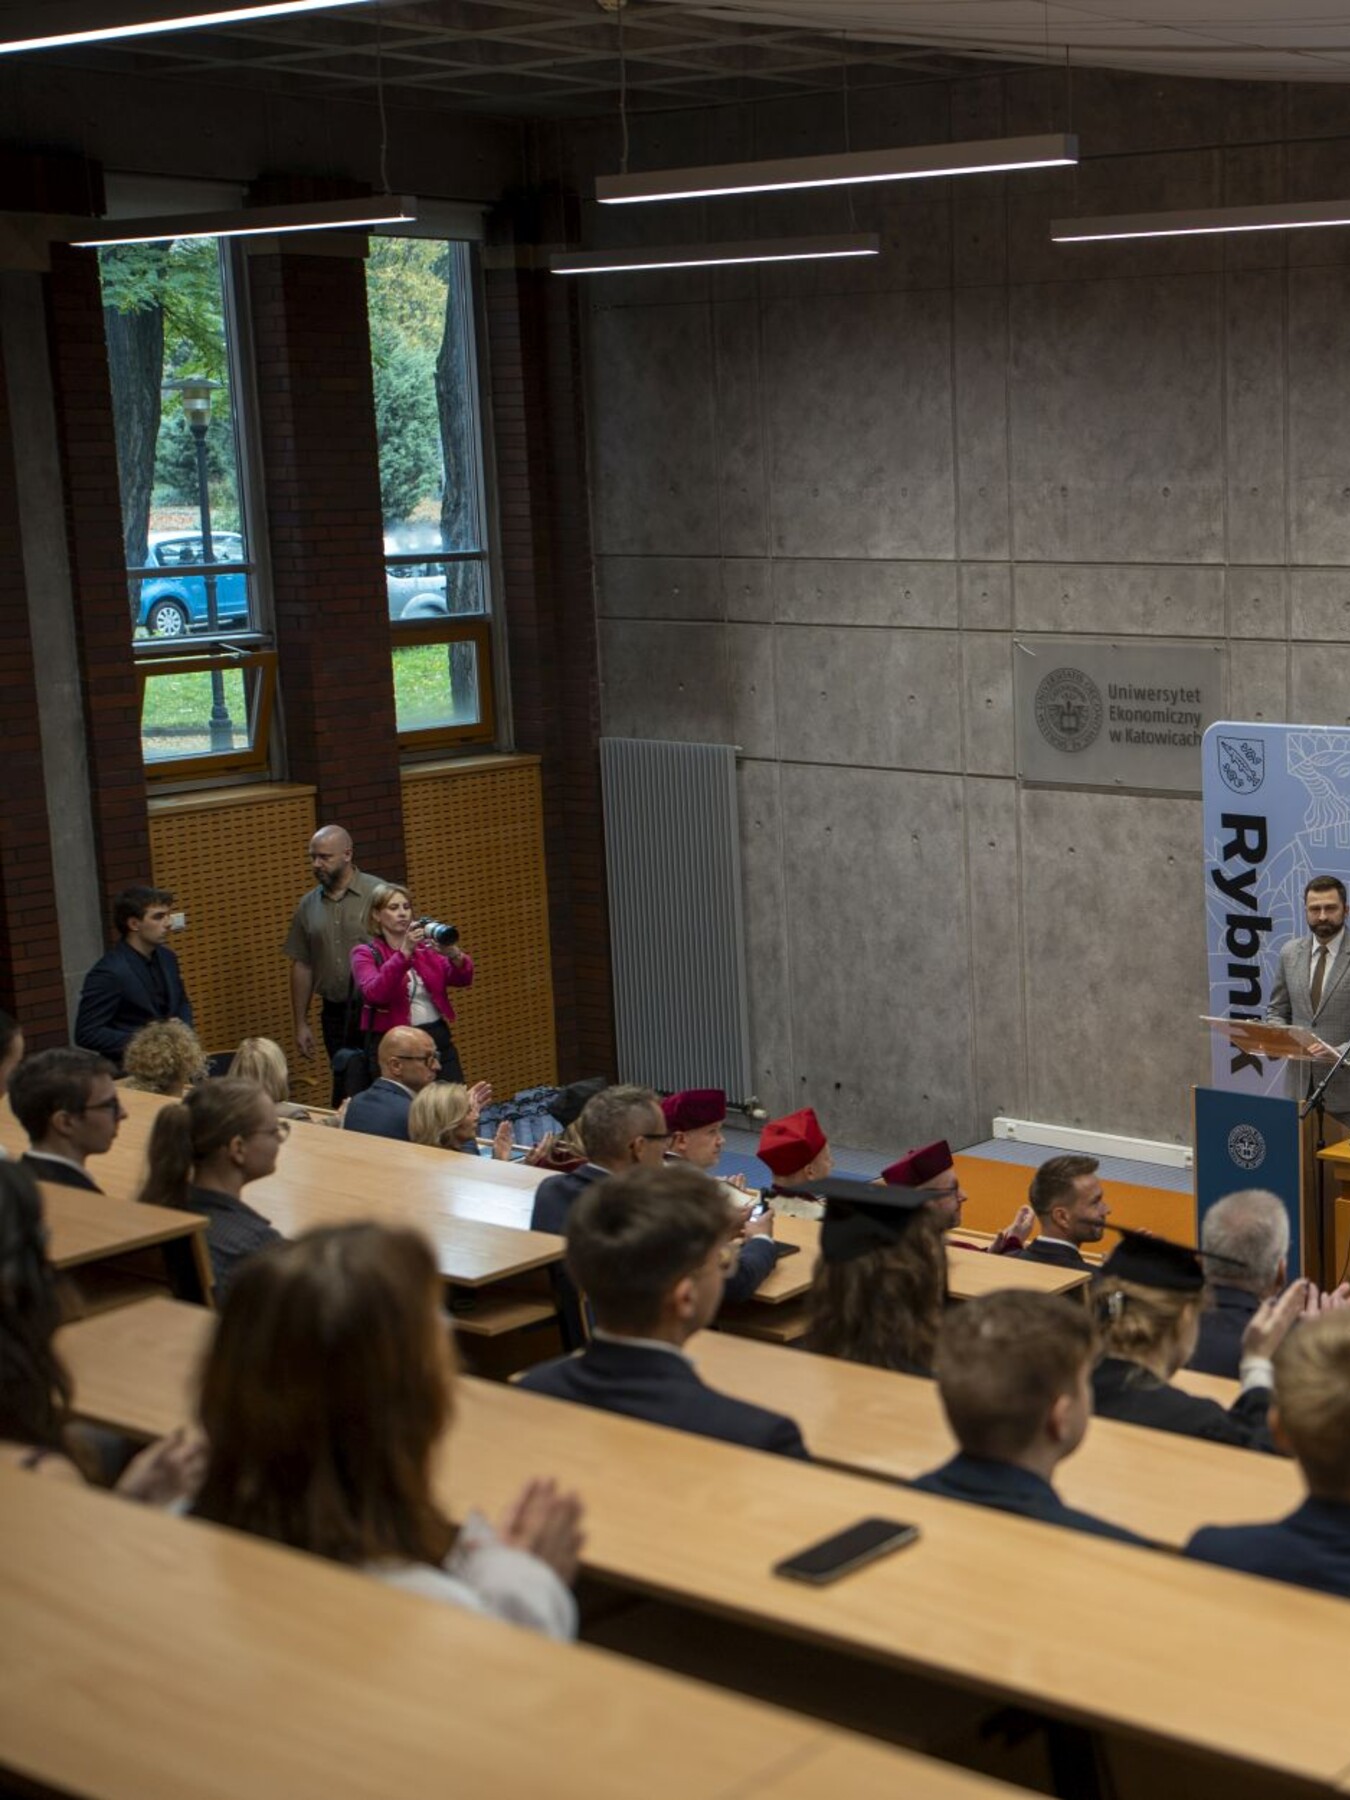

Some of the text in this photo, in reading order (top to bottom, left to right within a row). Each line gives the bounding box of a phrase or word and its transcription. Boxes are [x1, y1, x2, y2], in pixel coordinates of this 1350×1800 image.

[1108, 683, 1202, 706] Uniwersytet
[1109, 705, 1202, 728] Ekonomiczny
[1109, 727, 1202, 747] w Katowicach
